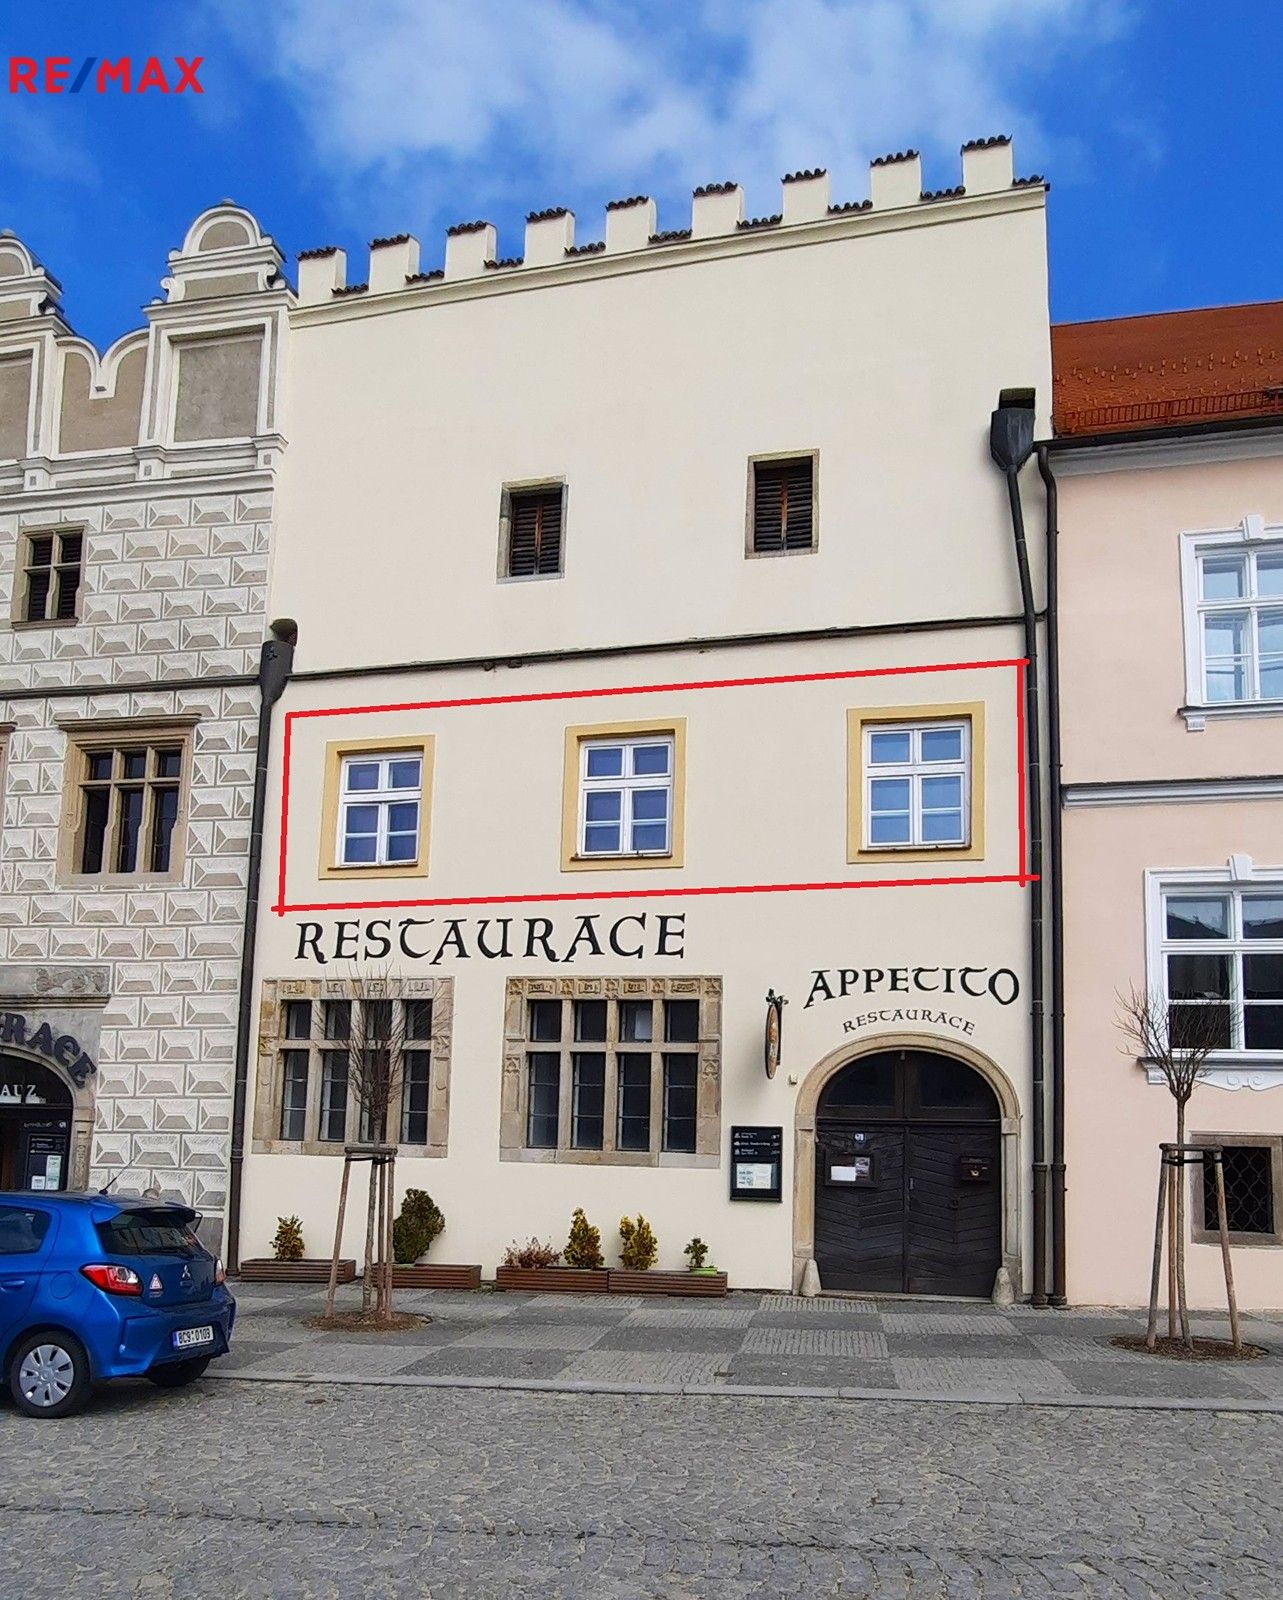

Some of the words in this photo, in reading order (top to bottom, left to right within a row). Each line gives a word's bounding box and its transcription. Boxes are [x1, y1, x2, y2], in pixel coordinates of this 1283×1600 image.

[294, 912, 686, 965] RESTAURACE
[803, 966, 1020, 1009] APPETITO
[842, 1008, 976, 1036] RESTAURACE
[0, 1012, 97, 1089] RACE
